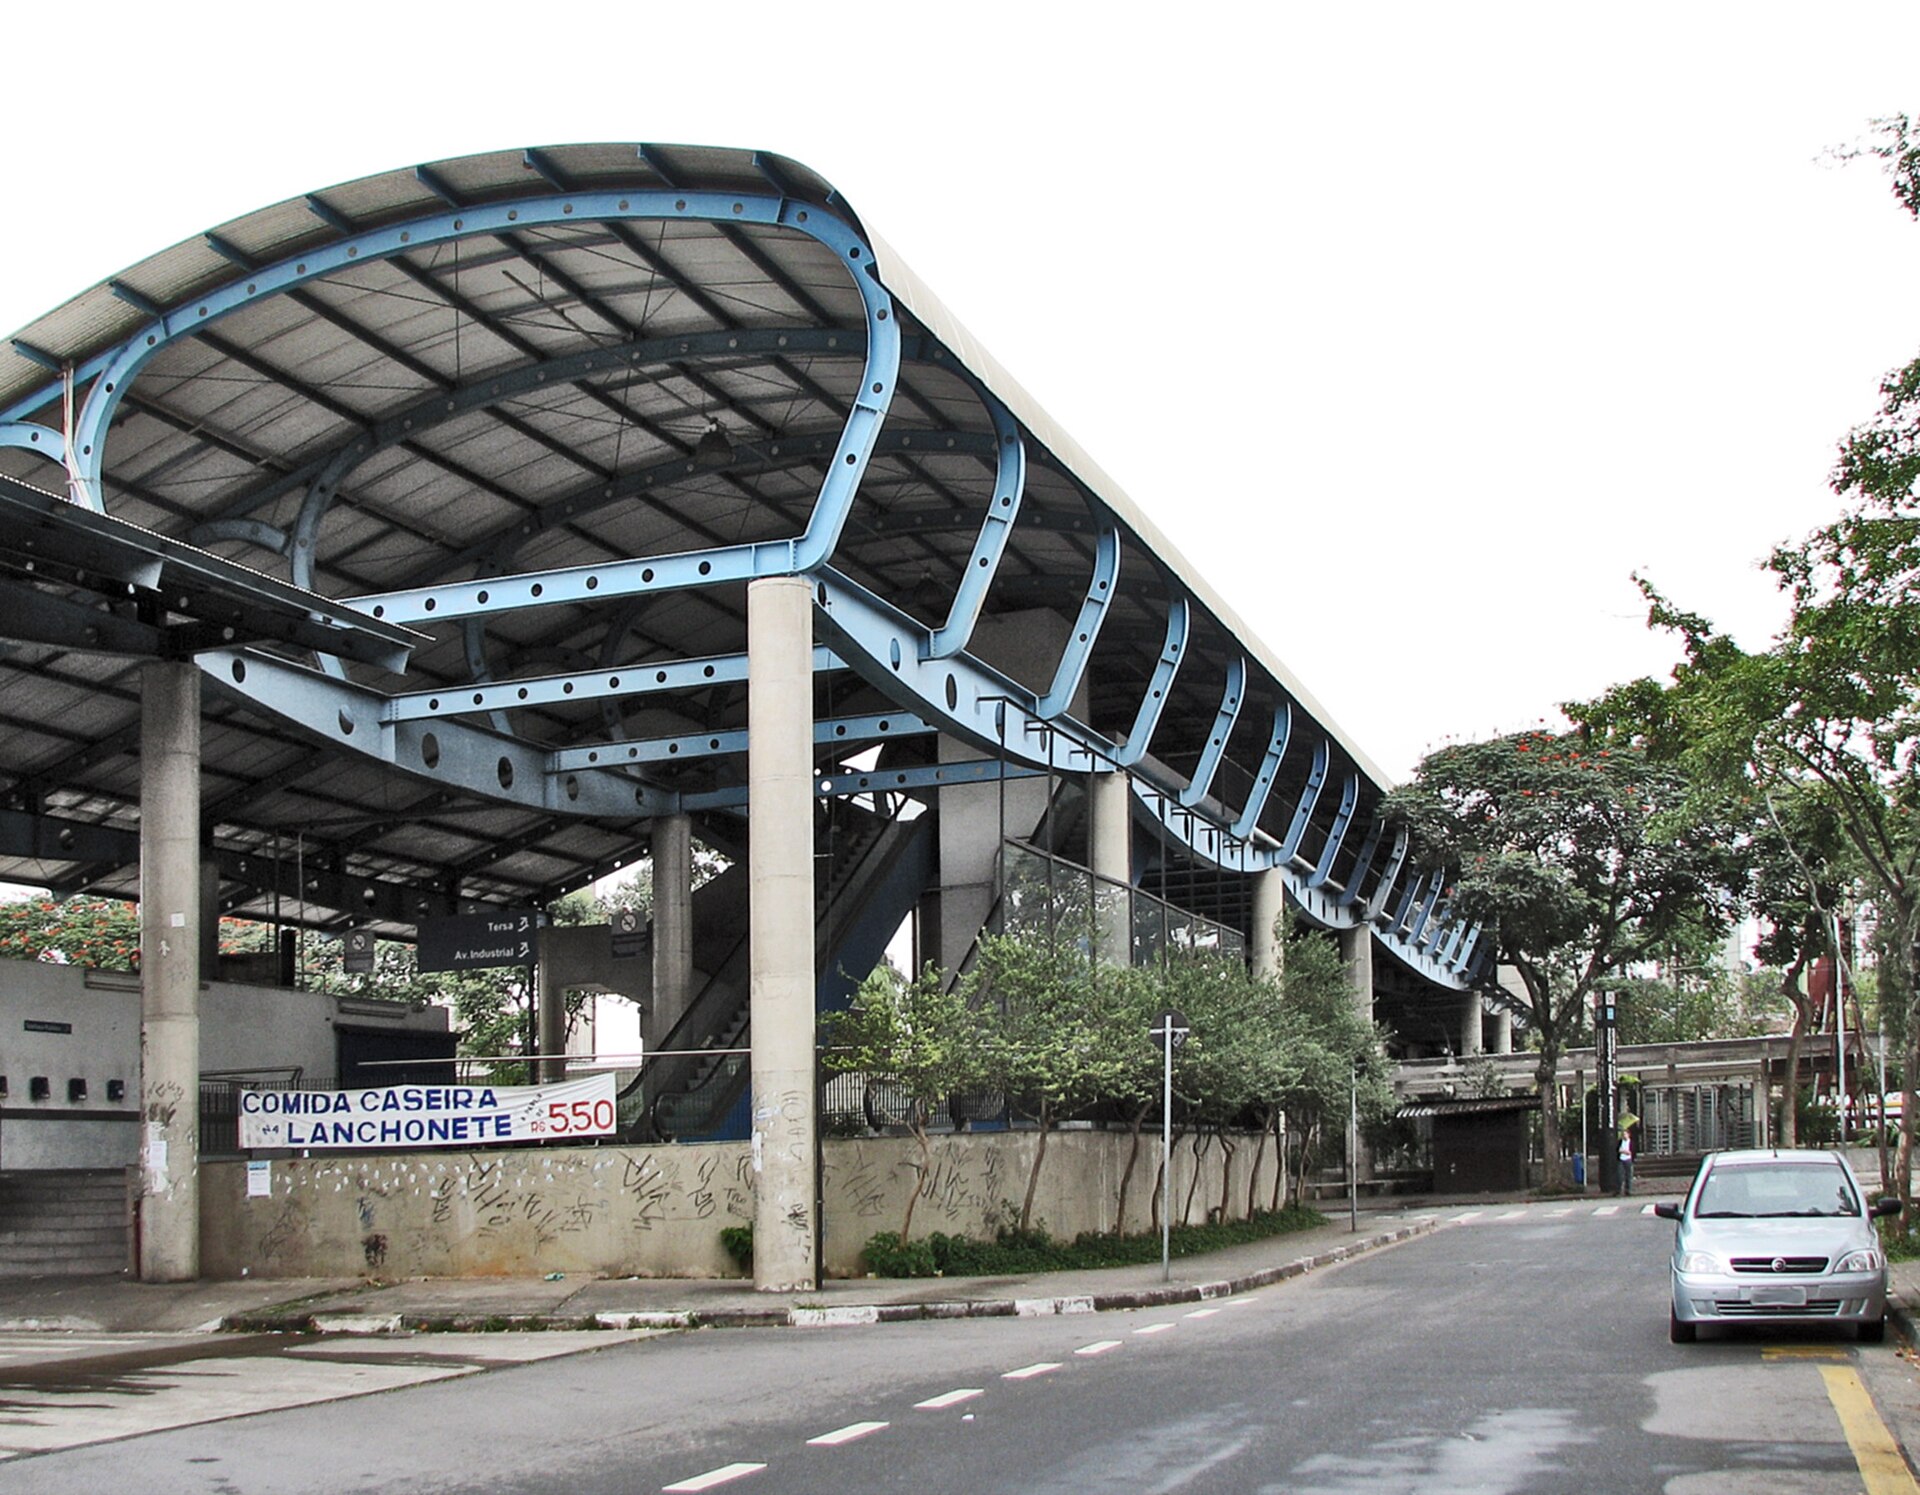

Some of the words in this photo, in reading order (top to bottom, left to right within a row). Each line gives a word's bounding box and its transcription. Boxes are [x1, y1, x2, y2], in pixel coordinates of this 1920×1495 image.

[488, 922, 513, 932] Tersa
[243, 1092, 351, 1114] COMIDA
[360, 1088, 498, 1112] CASEIRA
[288, 1114, 512, 1143] LANCHONETE
[548, 1100, 613, 1133] 5,50
